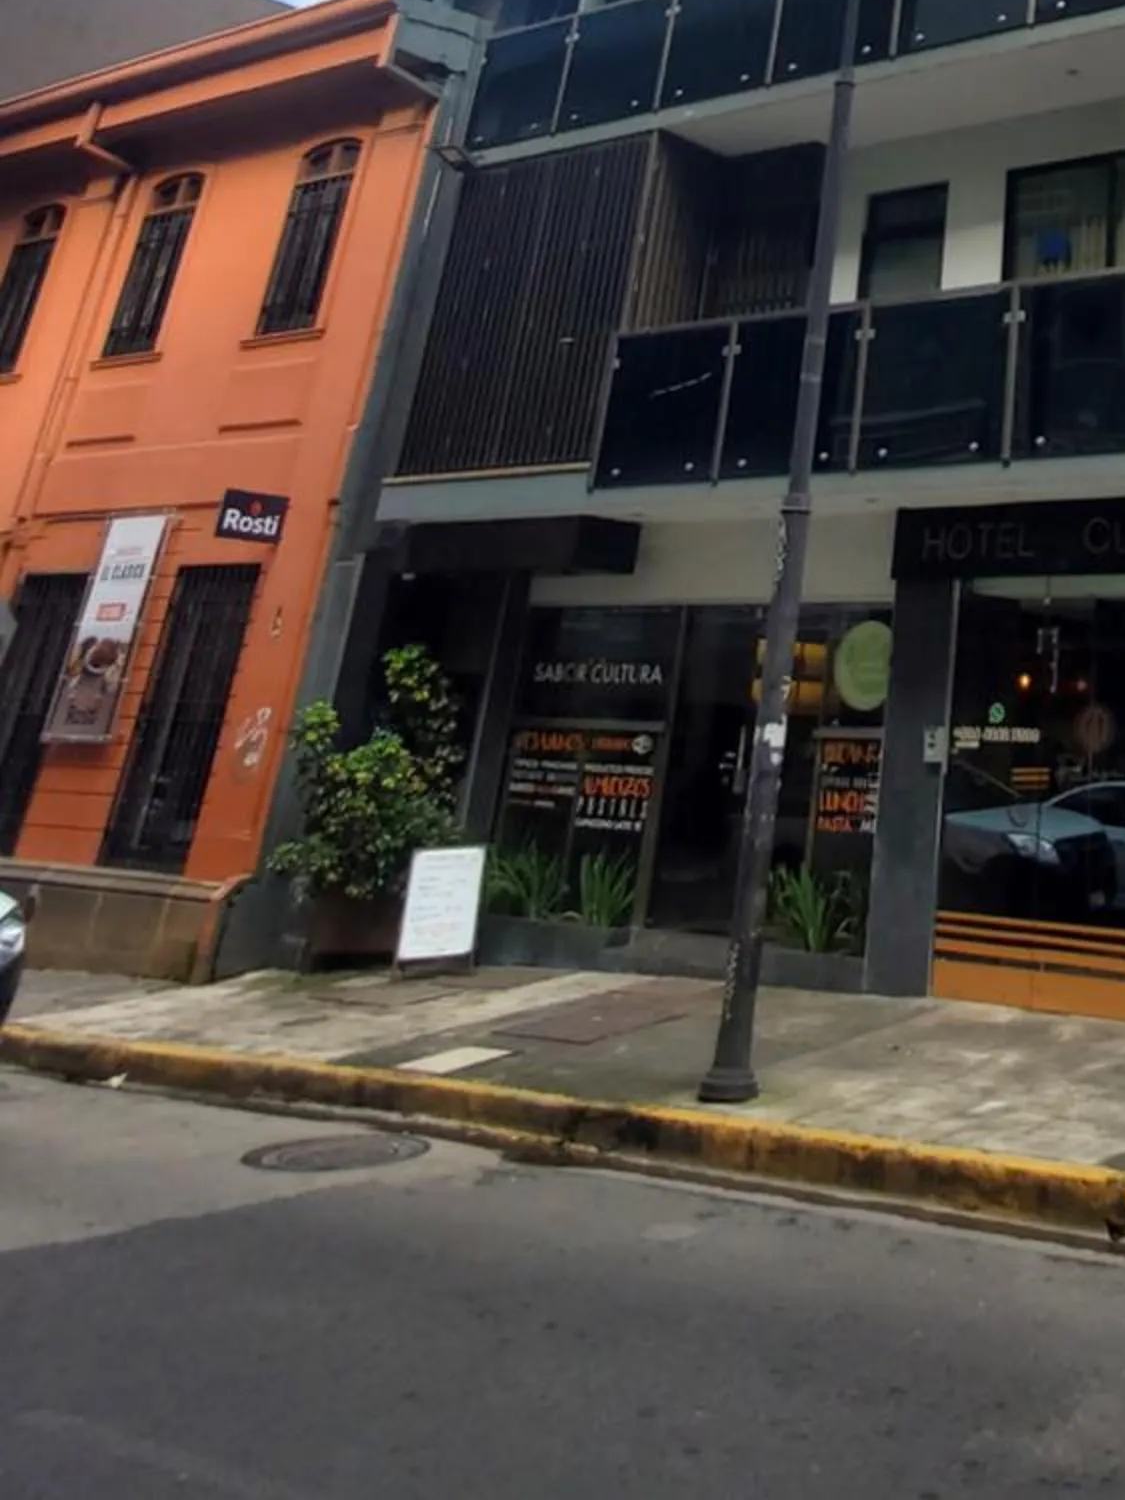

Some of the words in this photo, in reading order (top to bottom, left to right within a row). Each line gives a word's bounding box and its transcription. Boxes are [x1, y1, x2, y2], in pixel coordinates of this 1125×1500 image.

[222, 507, 281, 536] Rosti
[921, 522, 1036, 561] HOTEL
[589, 659, 663, 685] CULTURA
